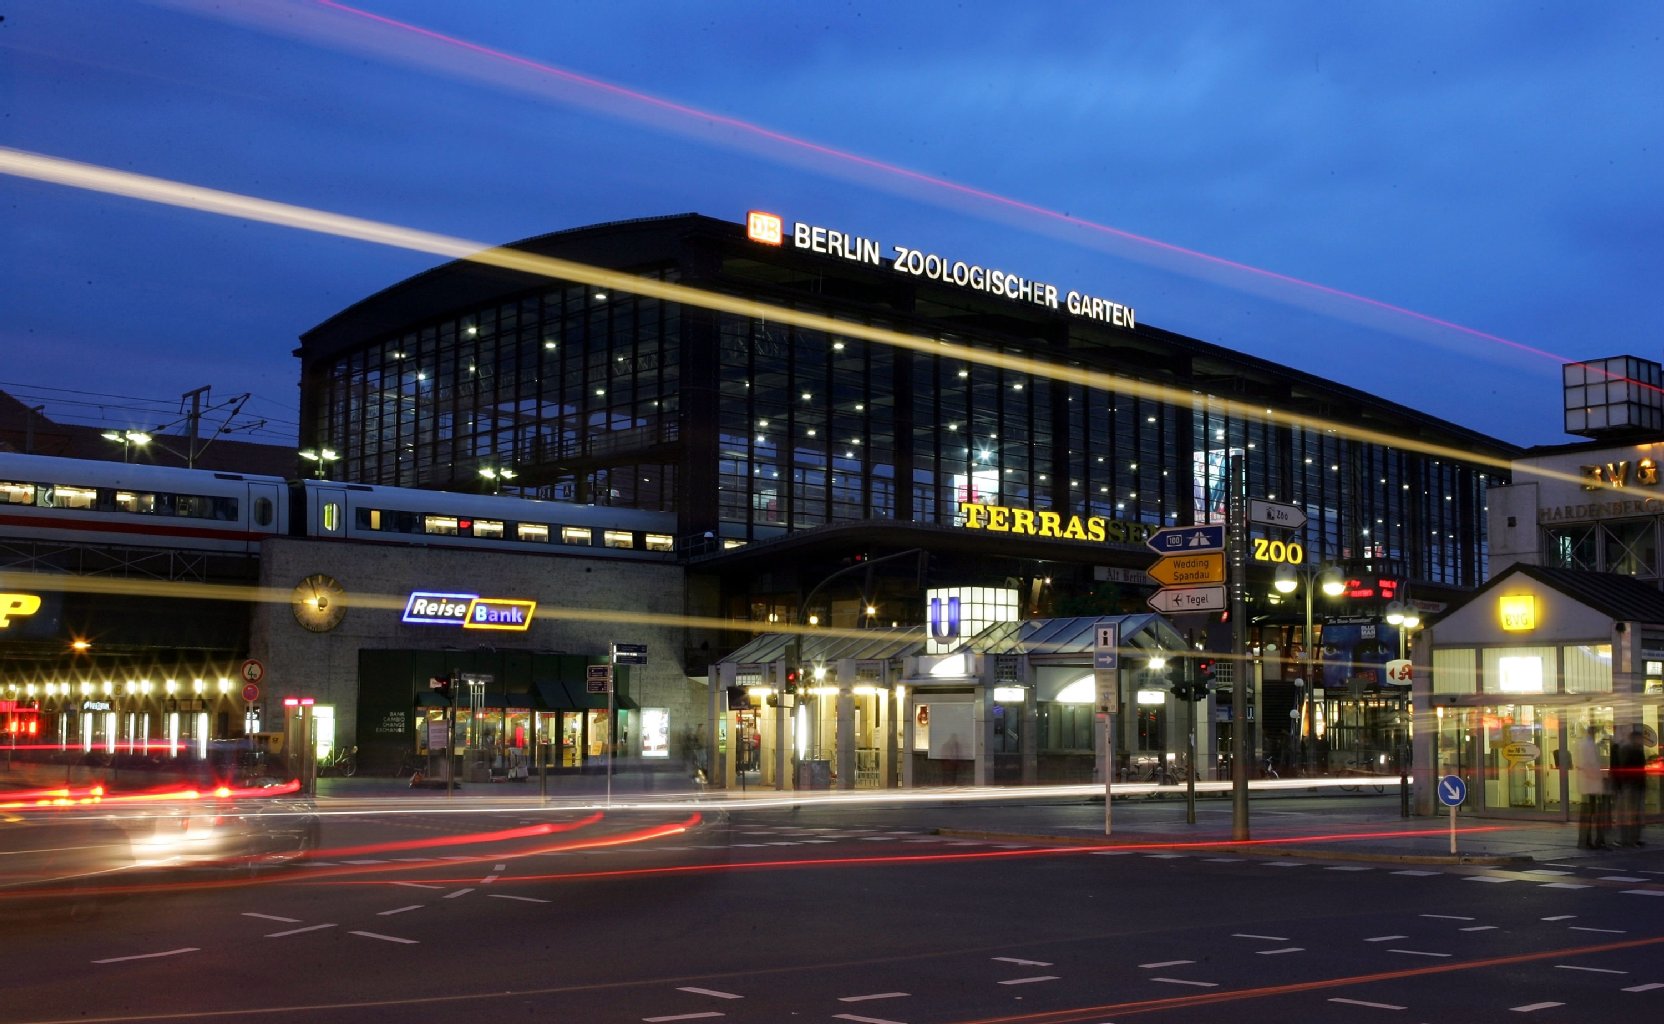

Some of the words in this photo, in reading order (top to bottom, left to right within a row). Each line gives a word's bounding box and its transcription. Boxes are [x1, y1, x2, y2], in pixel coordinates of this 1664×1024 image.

[751, 213, 780, 242] DB
[794, 223, 880, 265] BERLIN
[893, 246, 1058, 309] ZOOLOGISCHER
[1066, 290, 1135, 329] GARTEN
[1276, 509, 1289, 521] Zoo
[1169, 537, 1180, 545] 100
[1254, 538, 1303, 565] ZOO
[1173, 559, 1209, 569] Wedding
[1173, 571, 1210, 582] Spandau
[1186, 594, 1209, 606] Tegel
[412, 598, 466, 617] Reise
[475, 605, 523, 623] Bank
[930, 596, 961, 645] U
[1505, 612, 1528, 626] BVG
